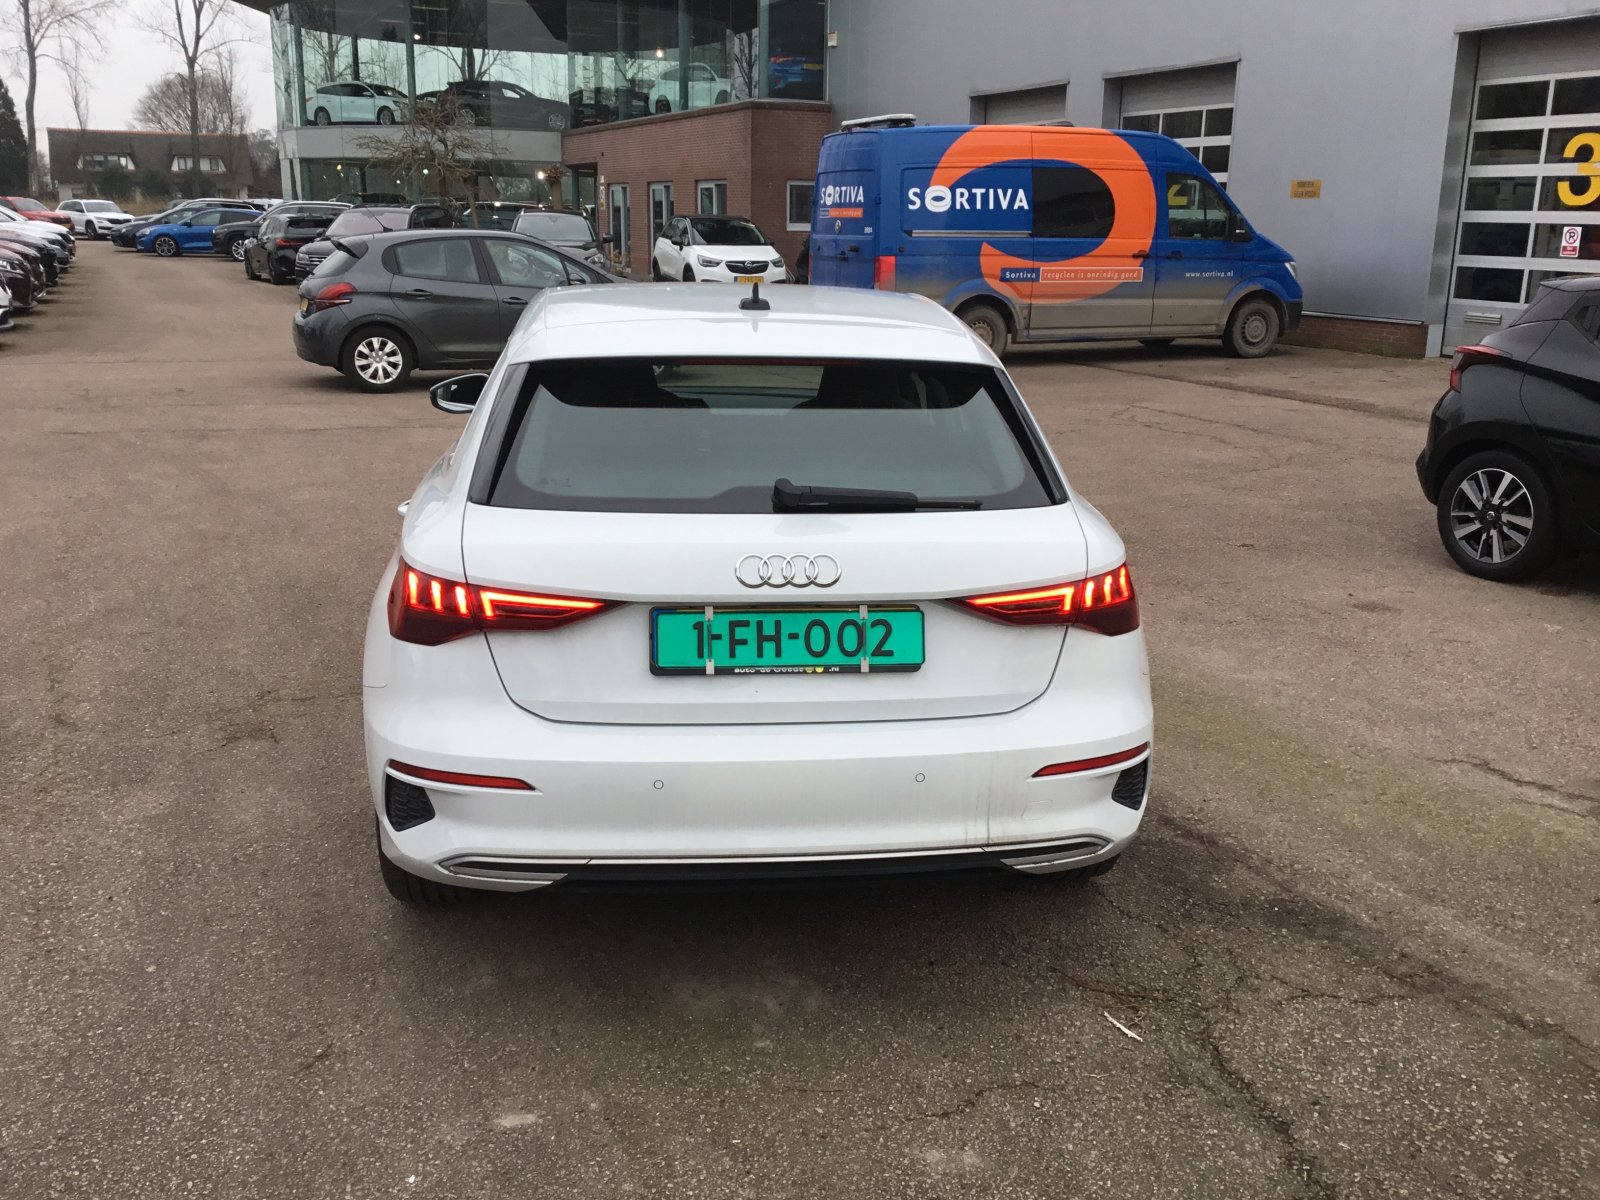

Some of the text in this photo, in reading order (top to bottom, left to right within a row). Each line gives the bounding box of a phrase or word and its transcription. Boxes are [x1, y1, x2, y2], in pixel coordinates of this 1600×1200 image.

[1557, 132, 1600, 206] 3
[820, 185, 864, 205] SORTIVA
[908, 185, 1029, 212] SORTIVA
[1005, 270, 1036, 279] Sortiva
[692, 618, 894, 659] 1-FH-002
